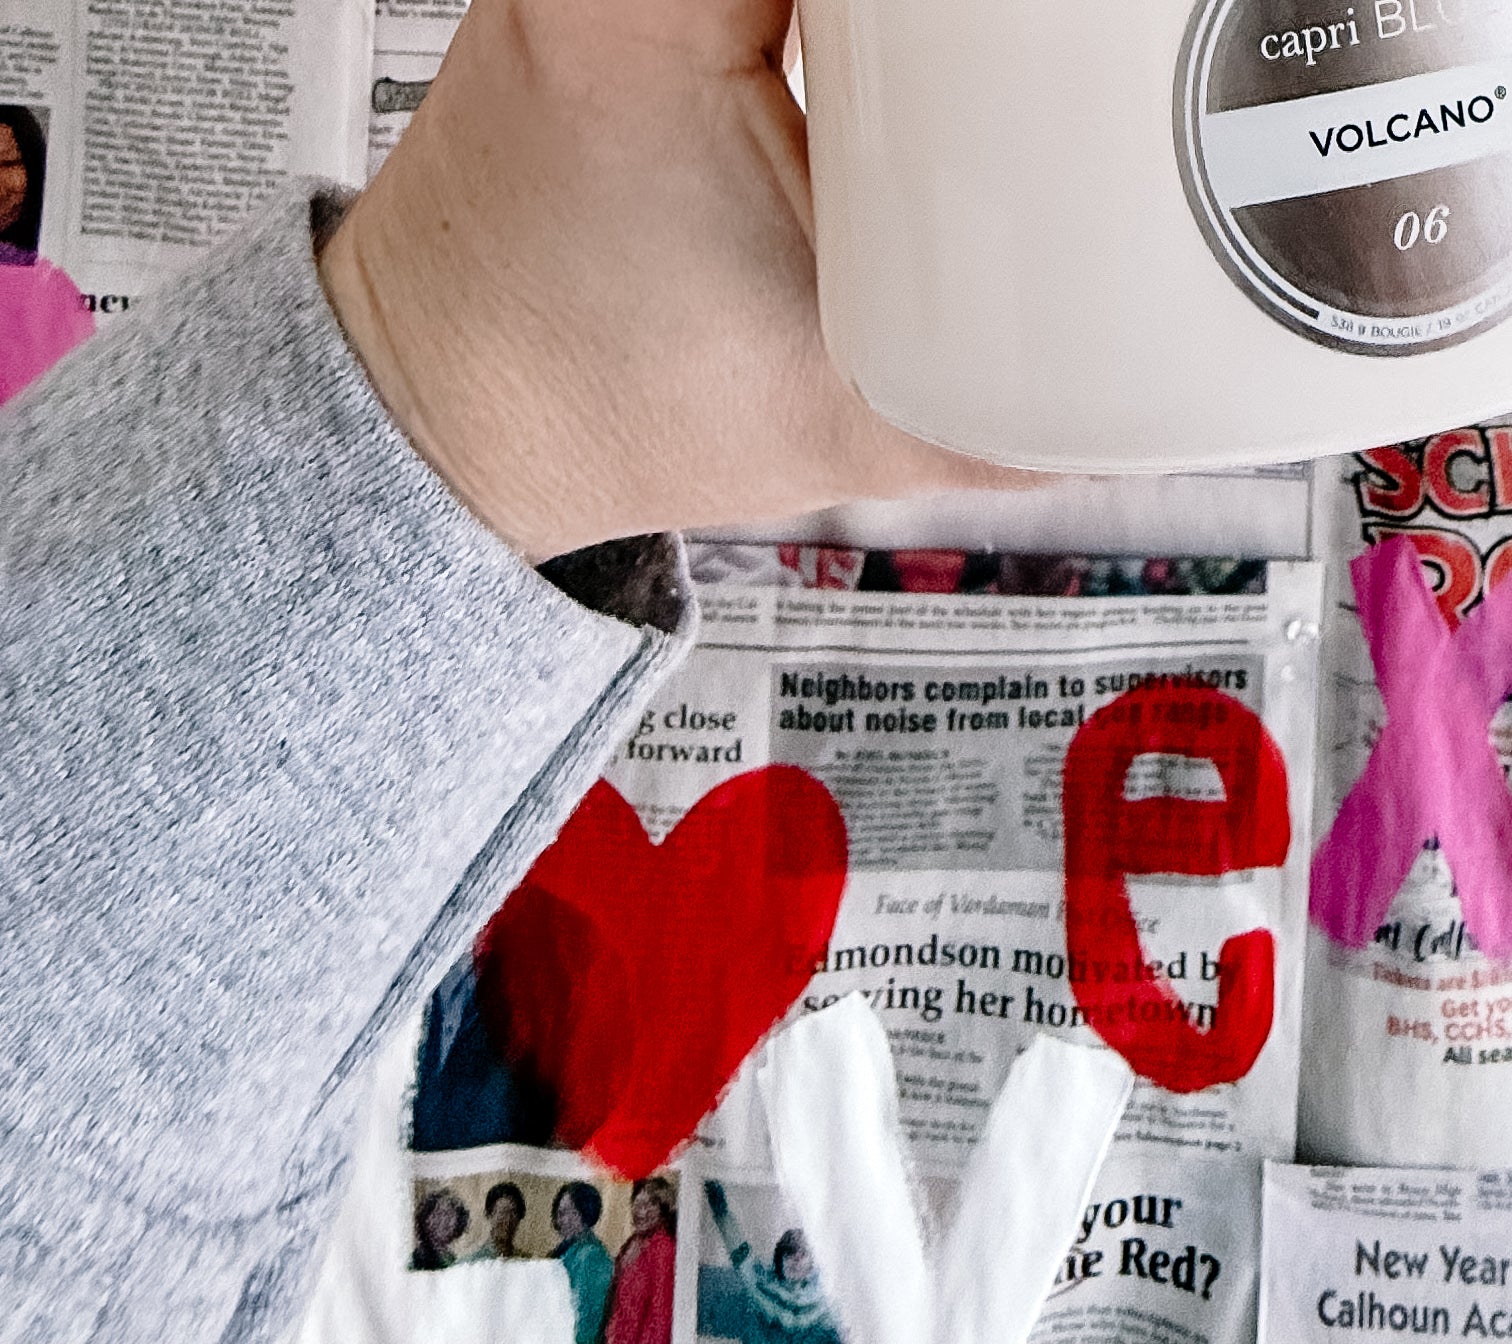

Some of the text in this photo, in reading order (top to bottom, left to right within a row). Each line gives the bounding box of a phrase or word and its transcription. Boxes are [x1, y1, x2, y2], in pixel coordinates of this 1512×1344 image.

[1260, 7, 1361, 66] capri
[1392, 203, 1452, 252] 06
[779, 671, 1086, 706] Neighbors complain to
[663, 703, 738, 732] close
[779, 704, 1087, 734] about noise from local
[625, 737, 743, 763] forward
[955, 979, 1015, 1019] her
[1441, 995, 1480, 1020] Get
[1441, 1045, 1473, 1066] All
[1076, 1194, 1183, 1244] your
[1118, 1237, 1221, 1301] Red?
[1354, 1238, 1429, 1280] New
[1316, 1288, 1451, 1335] Calhoun
